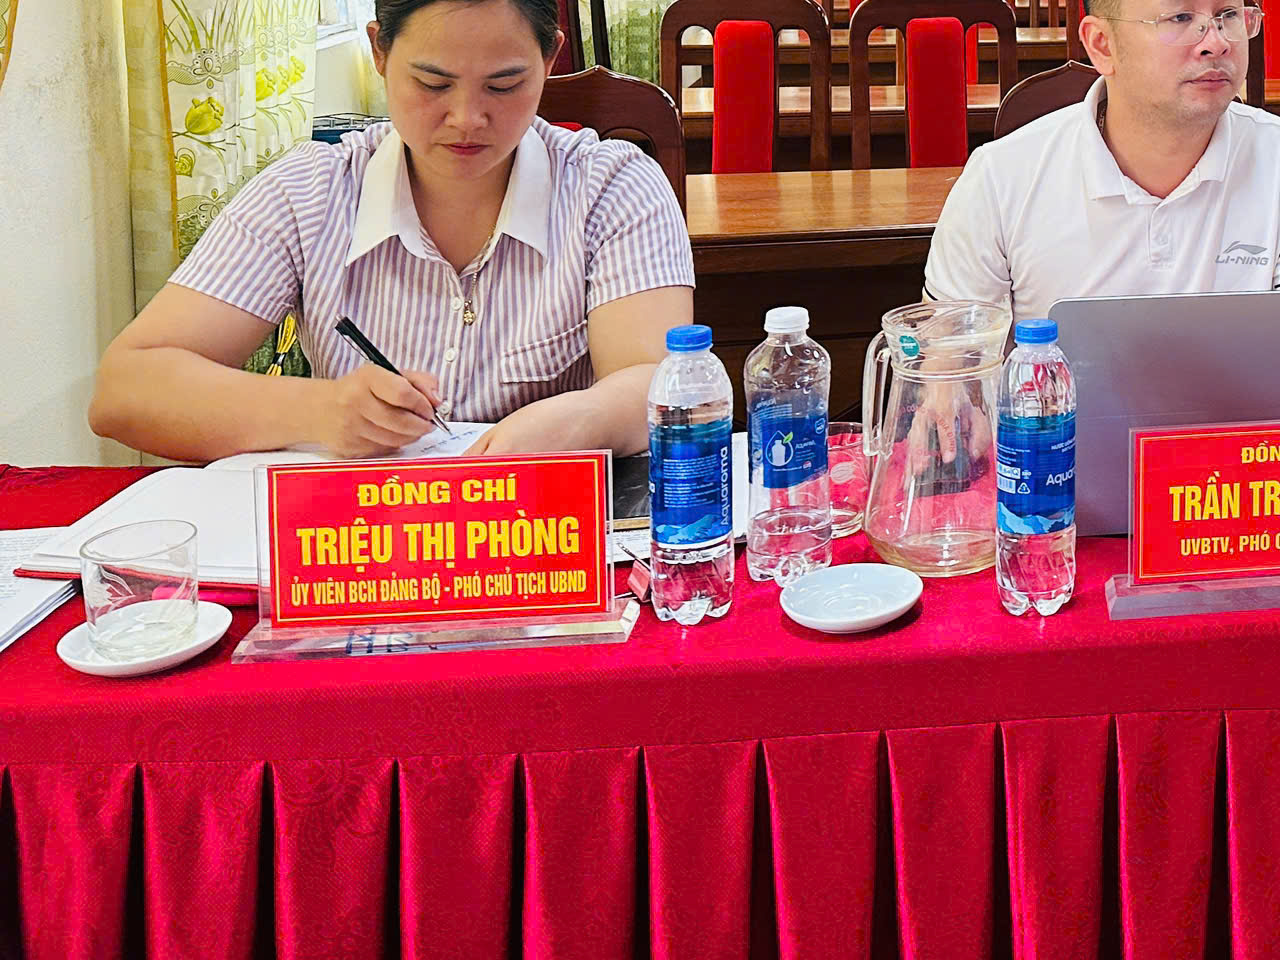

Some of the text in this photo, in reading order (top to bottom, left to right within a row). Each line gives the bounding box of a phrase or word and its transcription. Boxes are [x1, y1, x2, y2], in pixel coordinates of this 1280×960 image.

[1216, 255, 1268, 265] LI-NING
[358, 473, 516, 506] ĐỒNG CHÍ
[720, 446, 730, 526] Aquaroma
[1169, 471, 1240, 522] TRẦN
[297, 518, 393, 572] TRIỆU
[403, 521, 455, 568] THỊ
[467, 510, 580, 559] PHÒNG
[1180, 537, 1234, 556] UVBTV,
[1239, 530, 1270, 552] PHÓ
[291, 574, 309, 607] ỦY
[313, 577, 345, 605] VIÊN
[349, 580, 376, 602] BCH
[380, 572, 419, 601] ĐẢNG
[422, 575, 440, 605] BỘ
[454, 571, 482, 598] PHÓ
[485, 567, 513, 596] CHỦ
[516, 572, 546, 599] TỊCH
[550, 570, 586, 594] UBND
